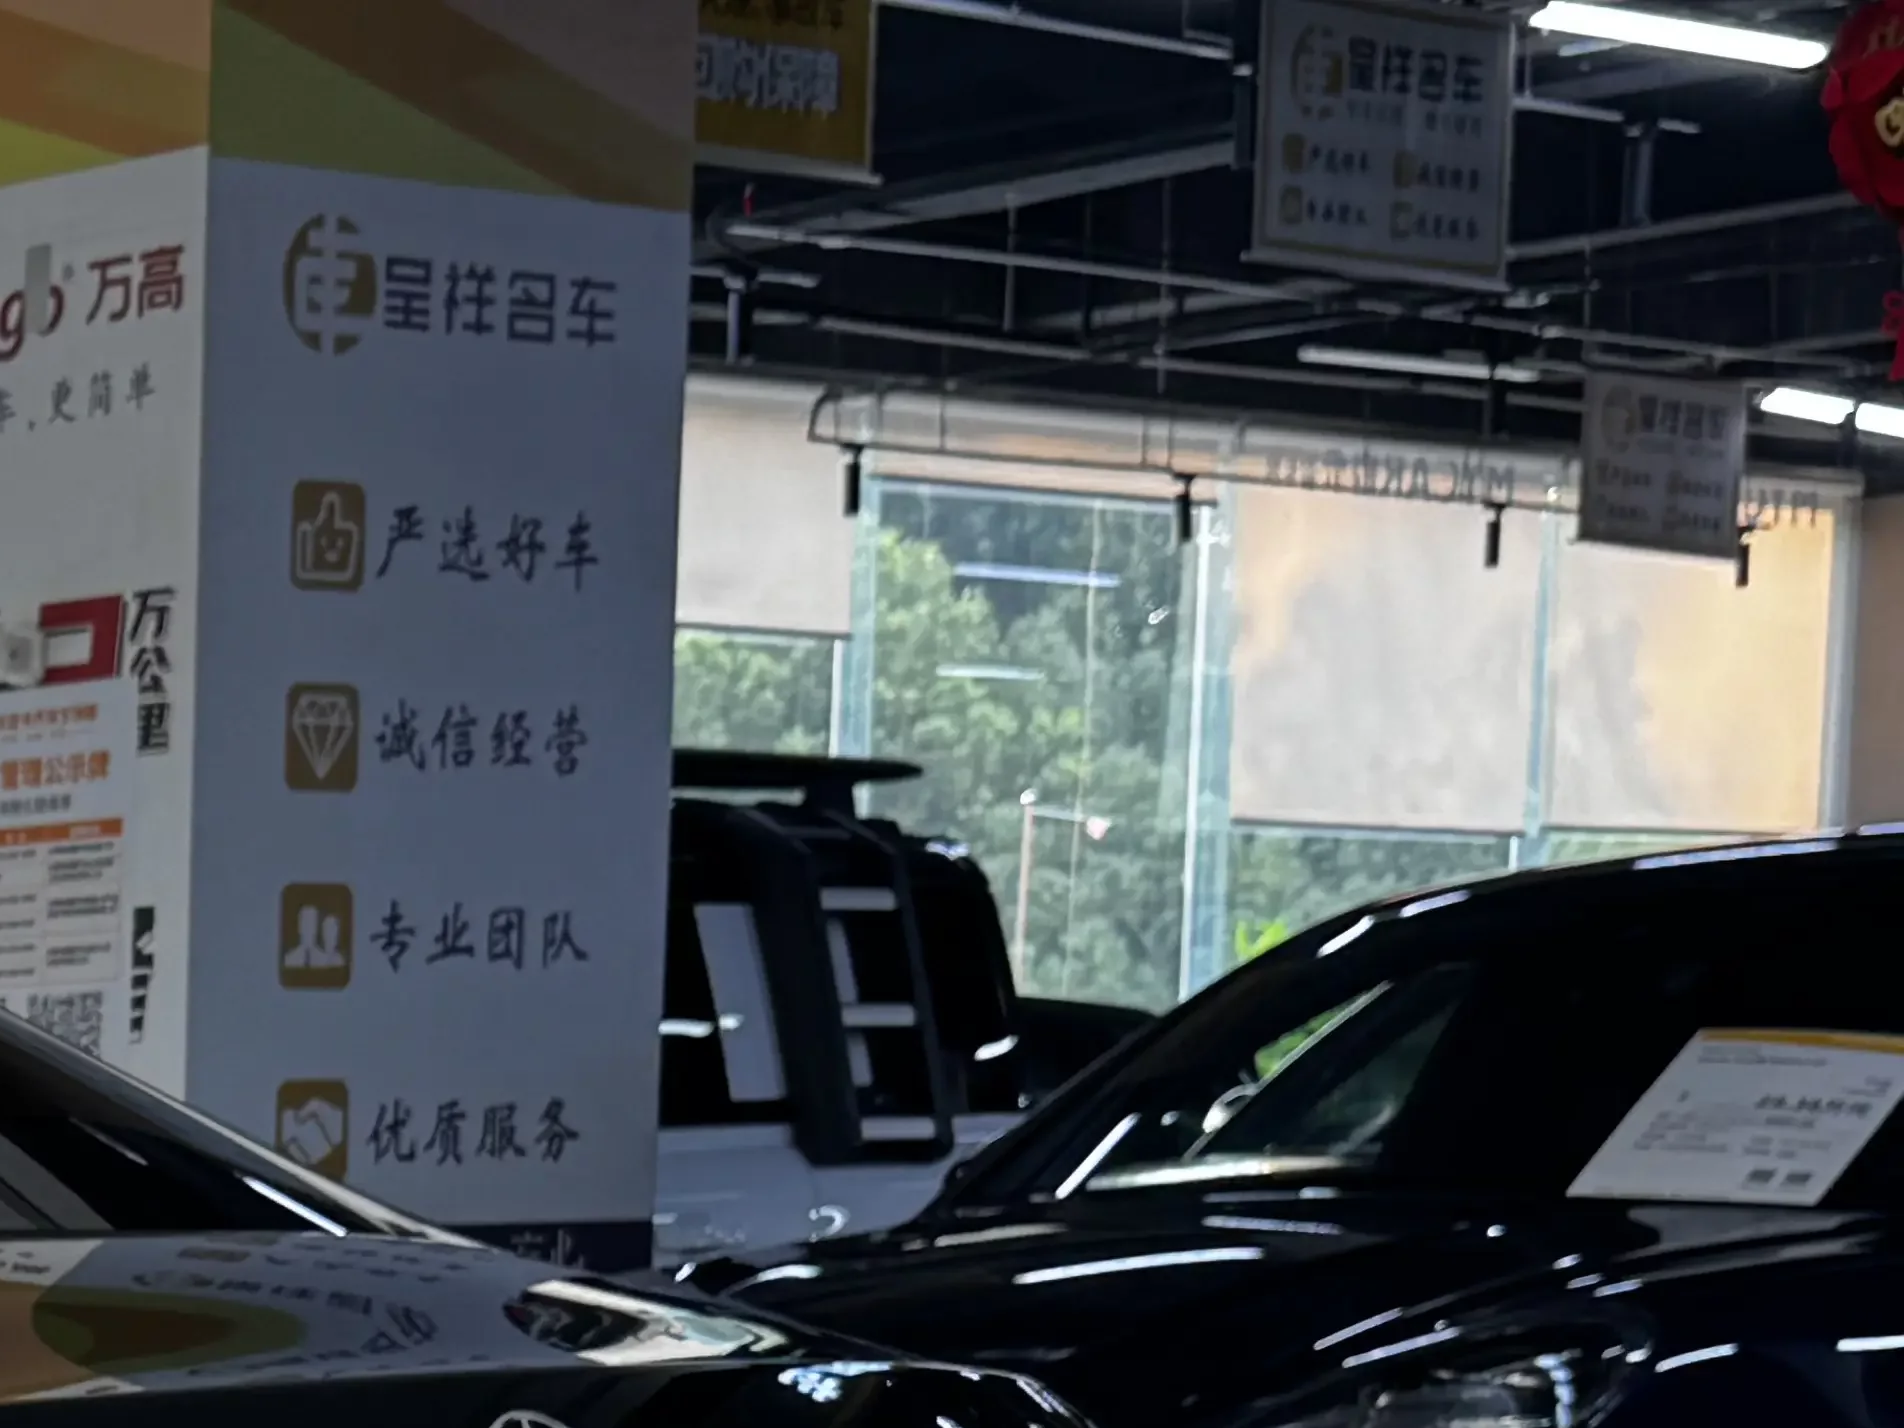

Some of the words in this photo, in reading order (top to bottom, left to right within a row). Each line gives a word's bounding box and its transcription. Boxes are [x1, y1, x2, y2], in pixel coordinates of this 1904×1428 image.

[86, 244, 185, 326] 万高
[383, 255, 618, 348] 呈祥名车
[375, 505, 600, 592] 严选好车
[374, 701, 590, 777] 诚信经营
[369, 902, 590, 973] 专业团队
[366, 1098, 580, 1167] 优质服务
